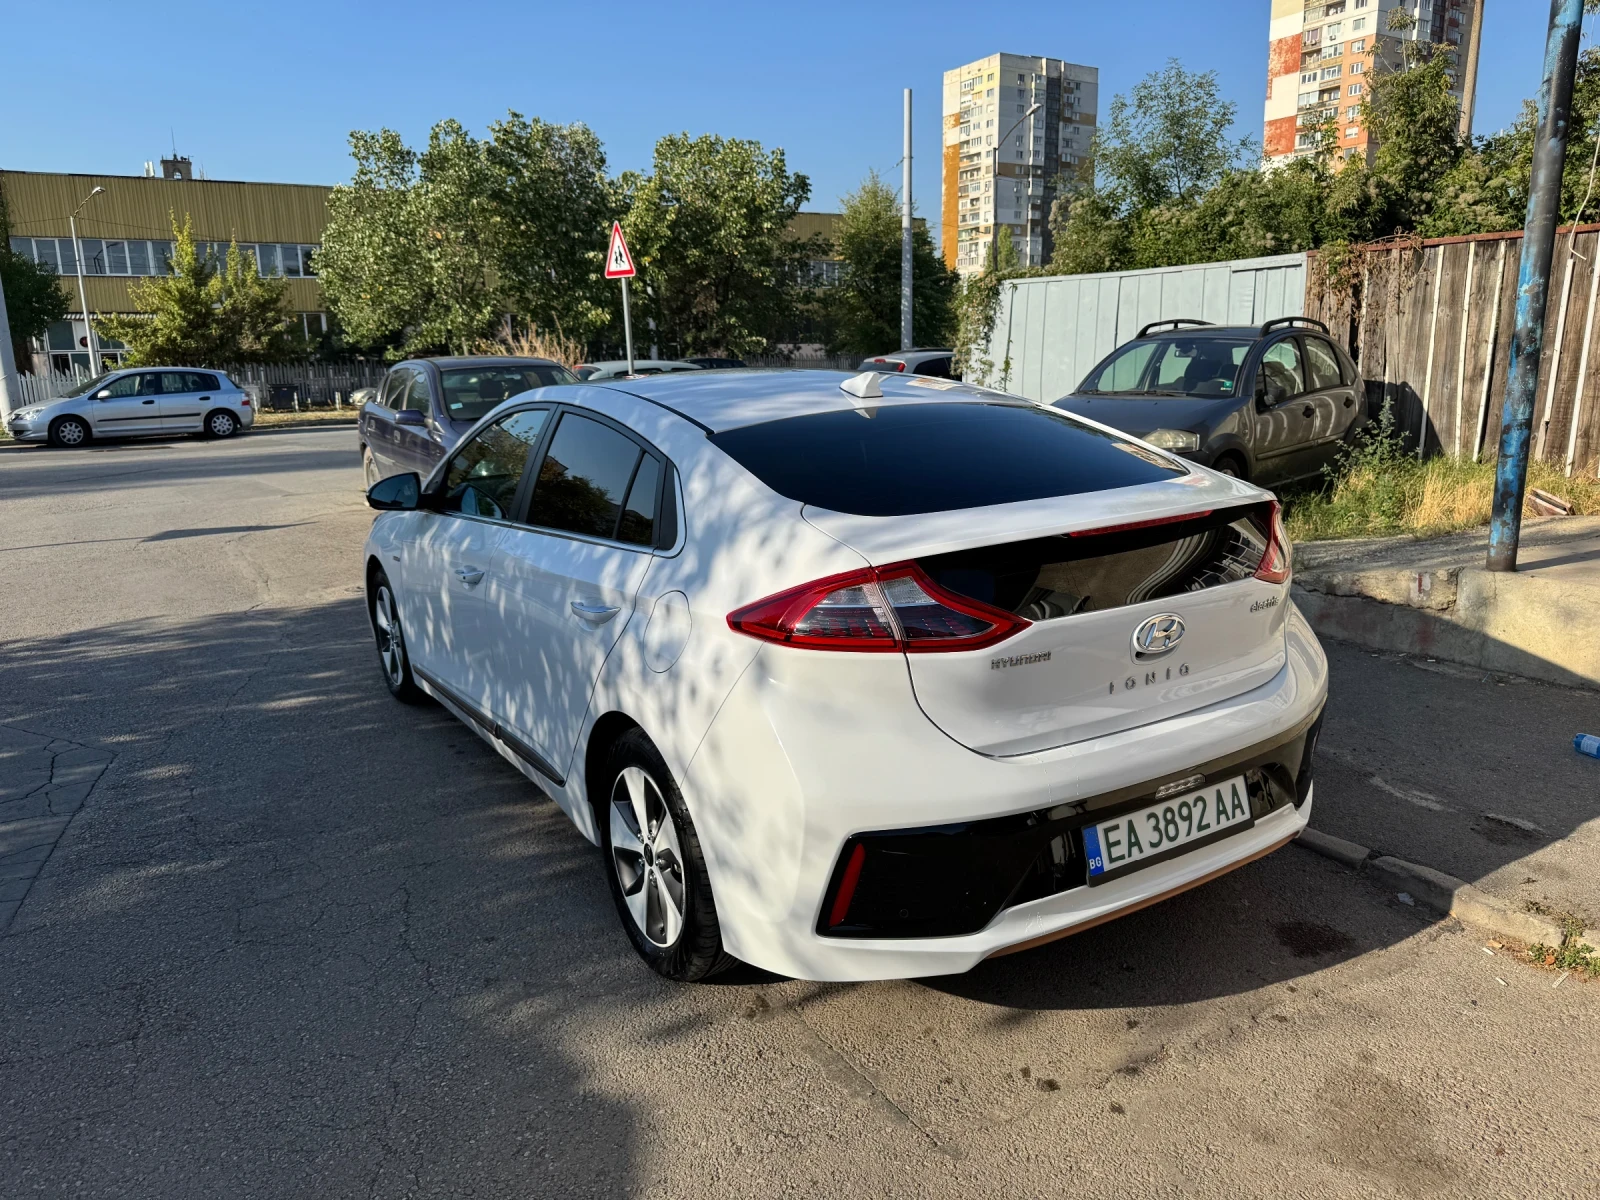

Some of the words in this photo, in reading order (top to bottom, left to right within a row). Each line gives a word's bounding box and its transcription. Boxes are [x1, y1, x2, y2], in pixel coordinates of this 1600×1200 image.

[991, 650, 1051, 670] HYUNDAI
[1103, 819, 1143, 864] EA
[1146, 795, 1210, 848] 3892
[1216, 783, 1245, 825] AA
[1089, 858, 1102, 869] BG
